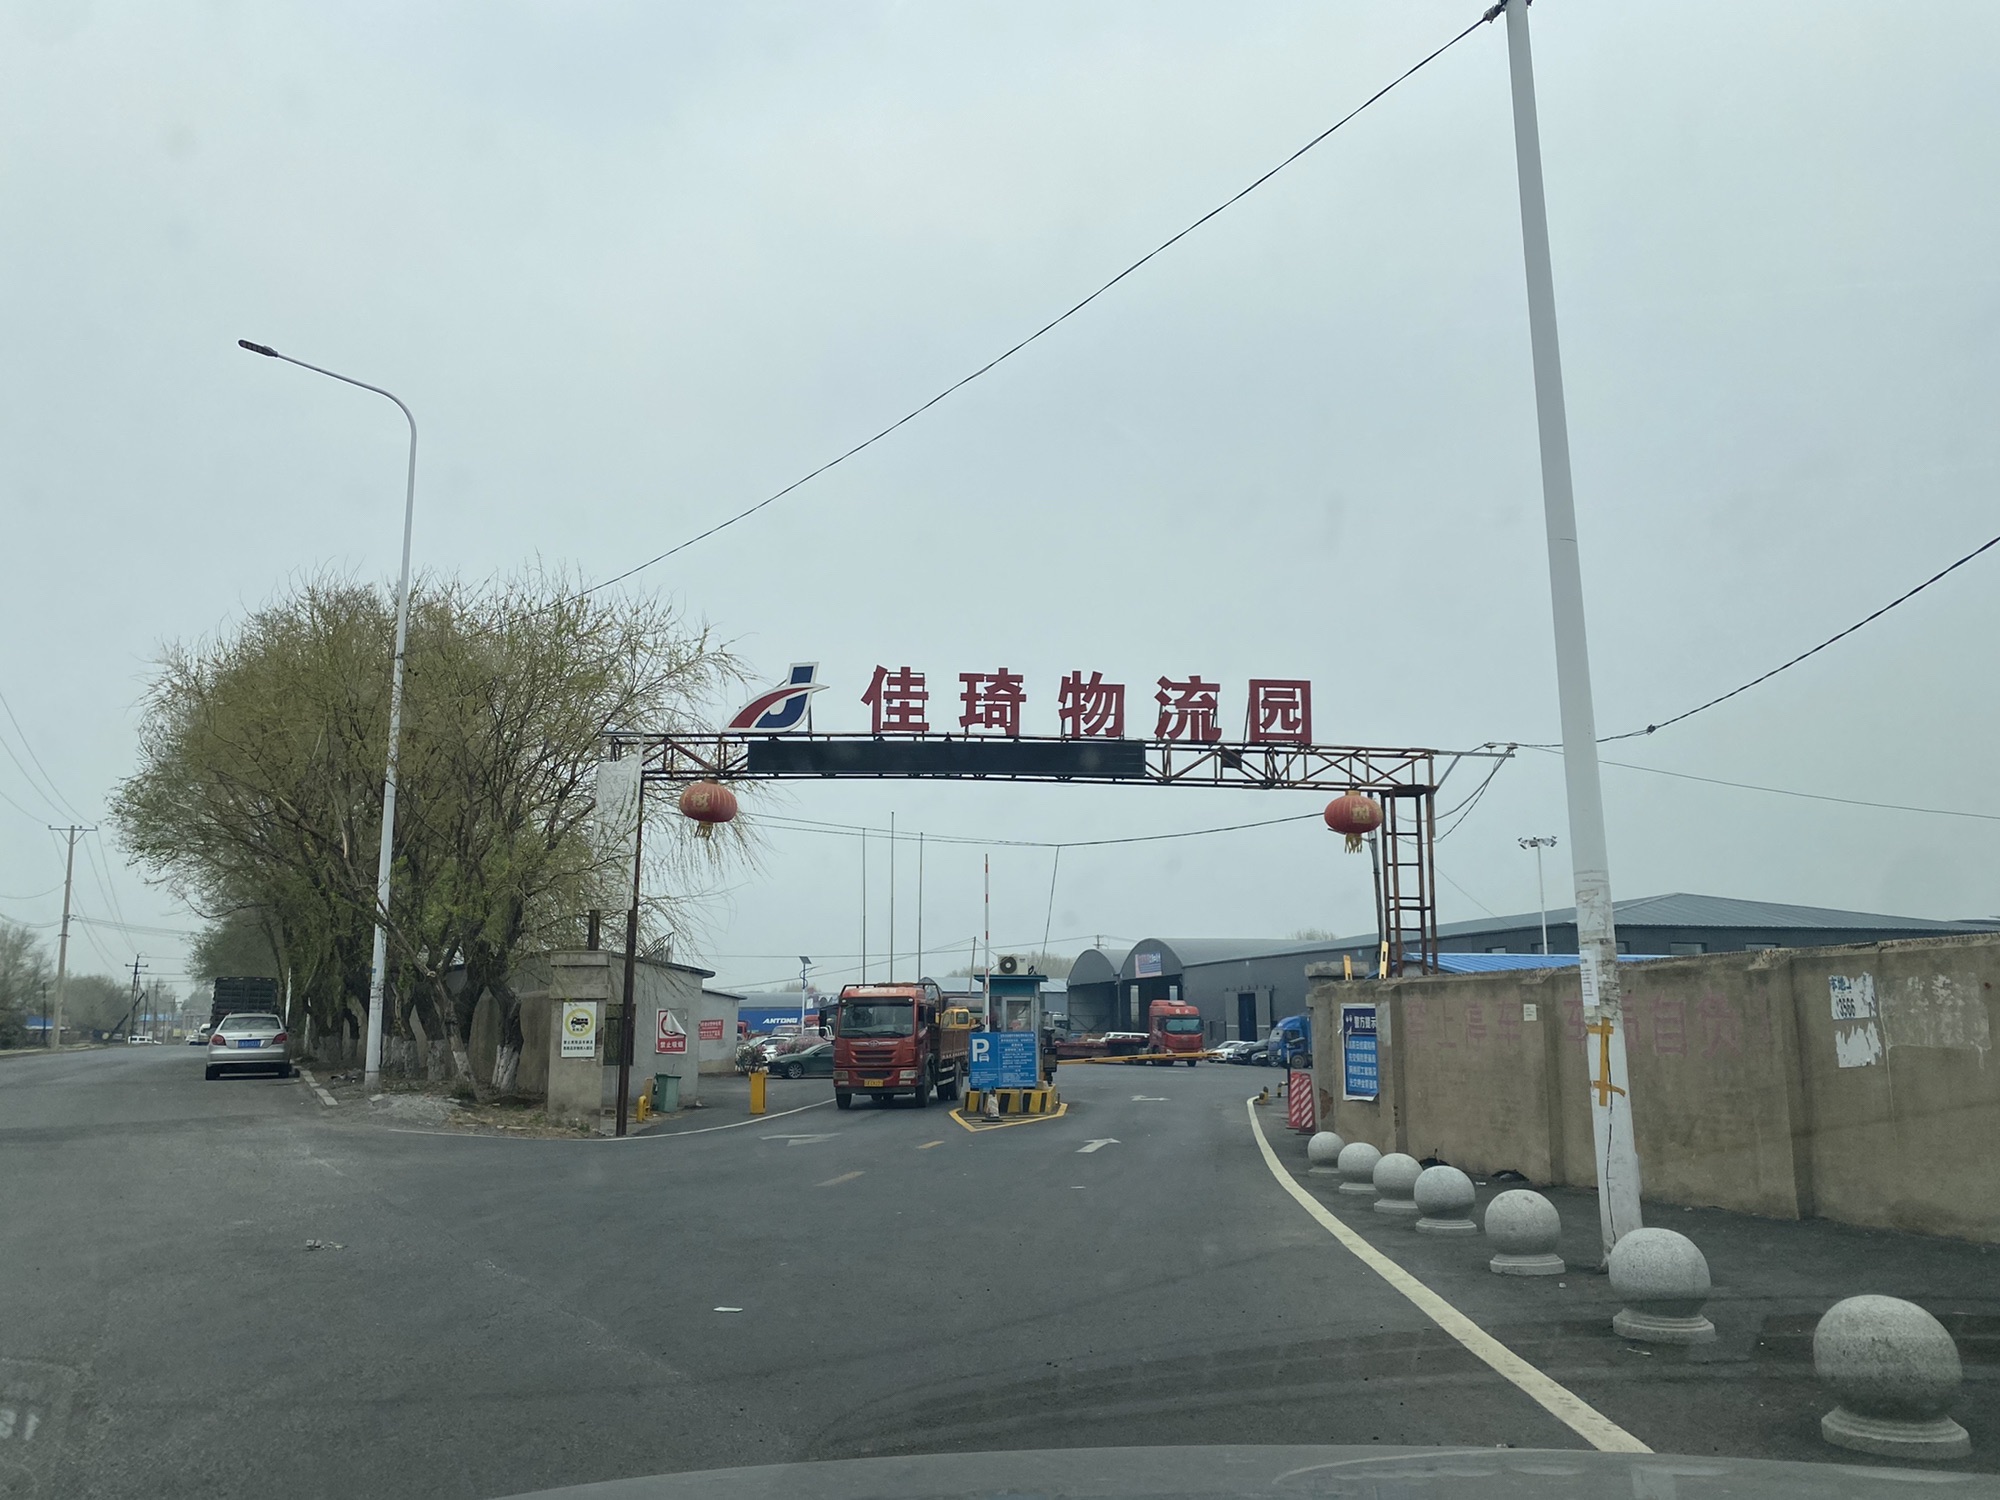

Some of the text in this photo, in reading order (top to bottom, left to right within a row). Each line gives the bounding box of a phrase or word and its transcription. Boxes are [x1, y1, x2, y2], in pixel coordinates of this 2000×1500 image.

[861, 664, 1312, 745] 佳琦物流园
[972, 1039, 989, 1062] P
